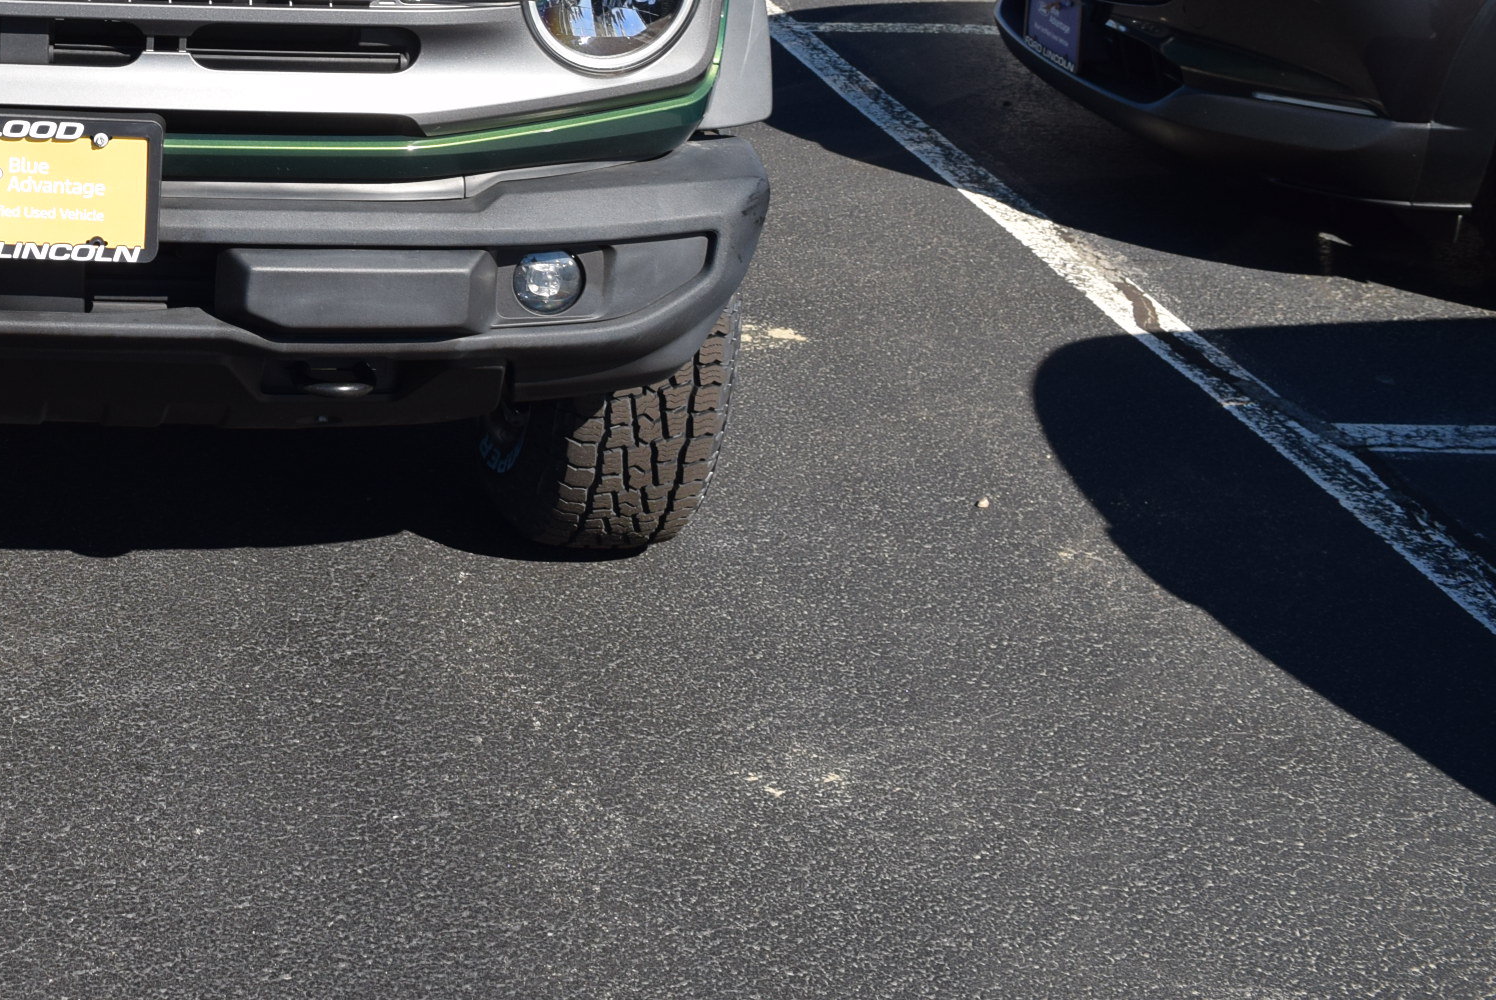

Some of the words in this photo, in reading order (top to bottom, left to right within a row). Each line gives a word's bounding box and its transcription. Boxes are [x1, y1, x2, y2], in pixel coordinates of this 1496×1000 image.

[8, 157, 50, 174] Blue
[7, 177, 106, 198] Advantage
[24, 207, 56, 219] Used
[59, 208, 105, 221] Vehicle
